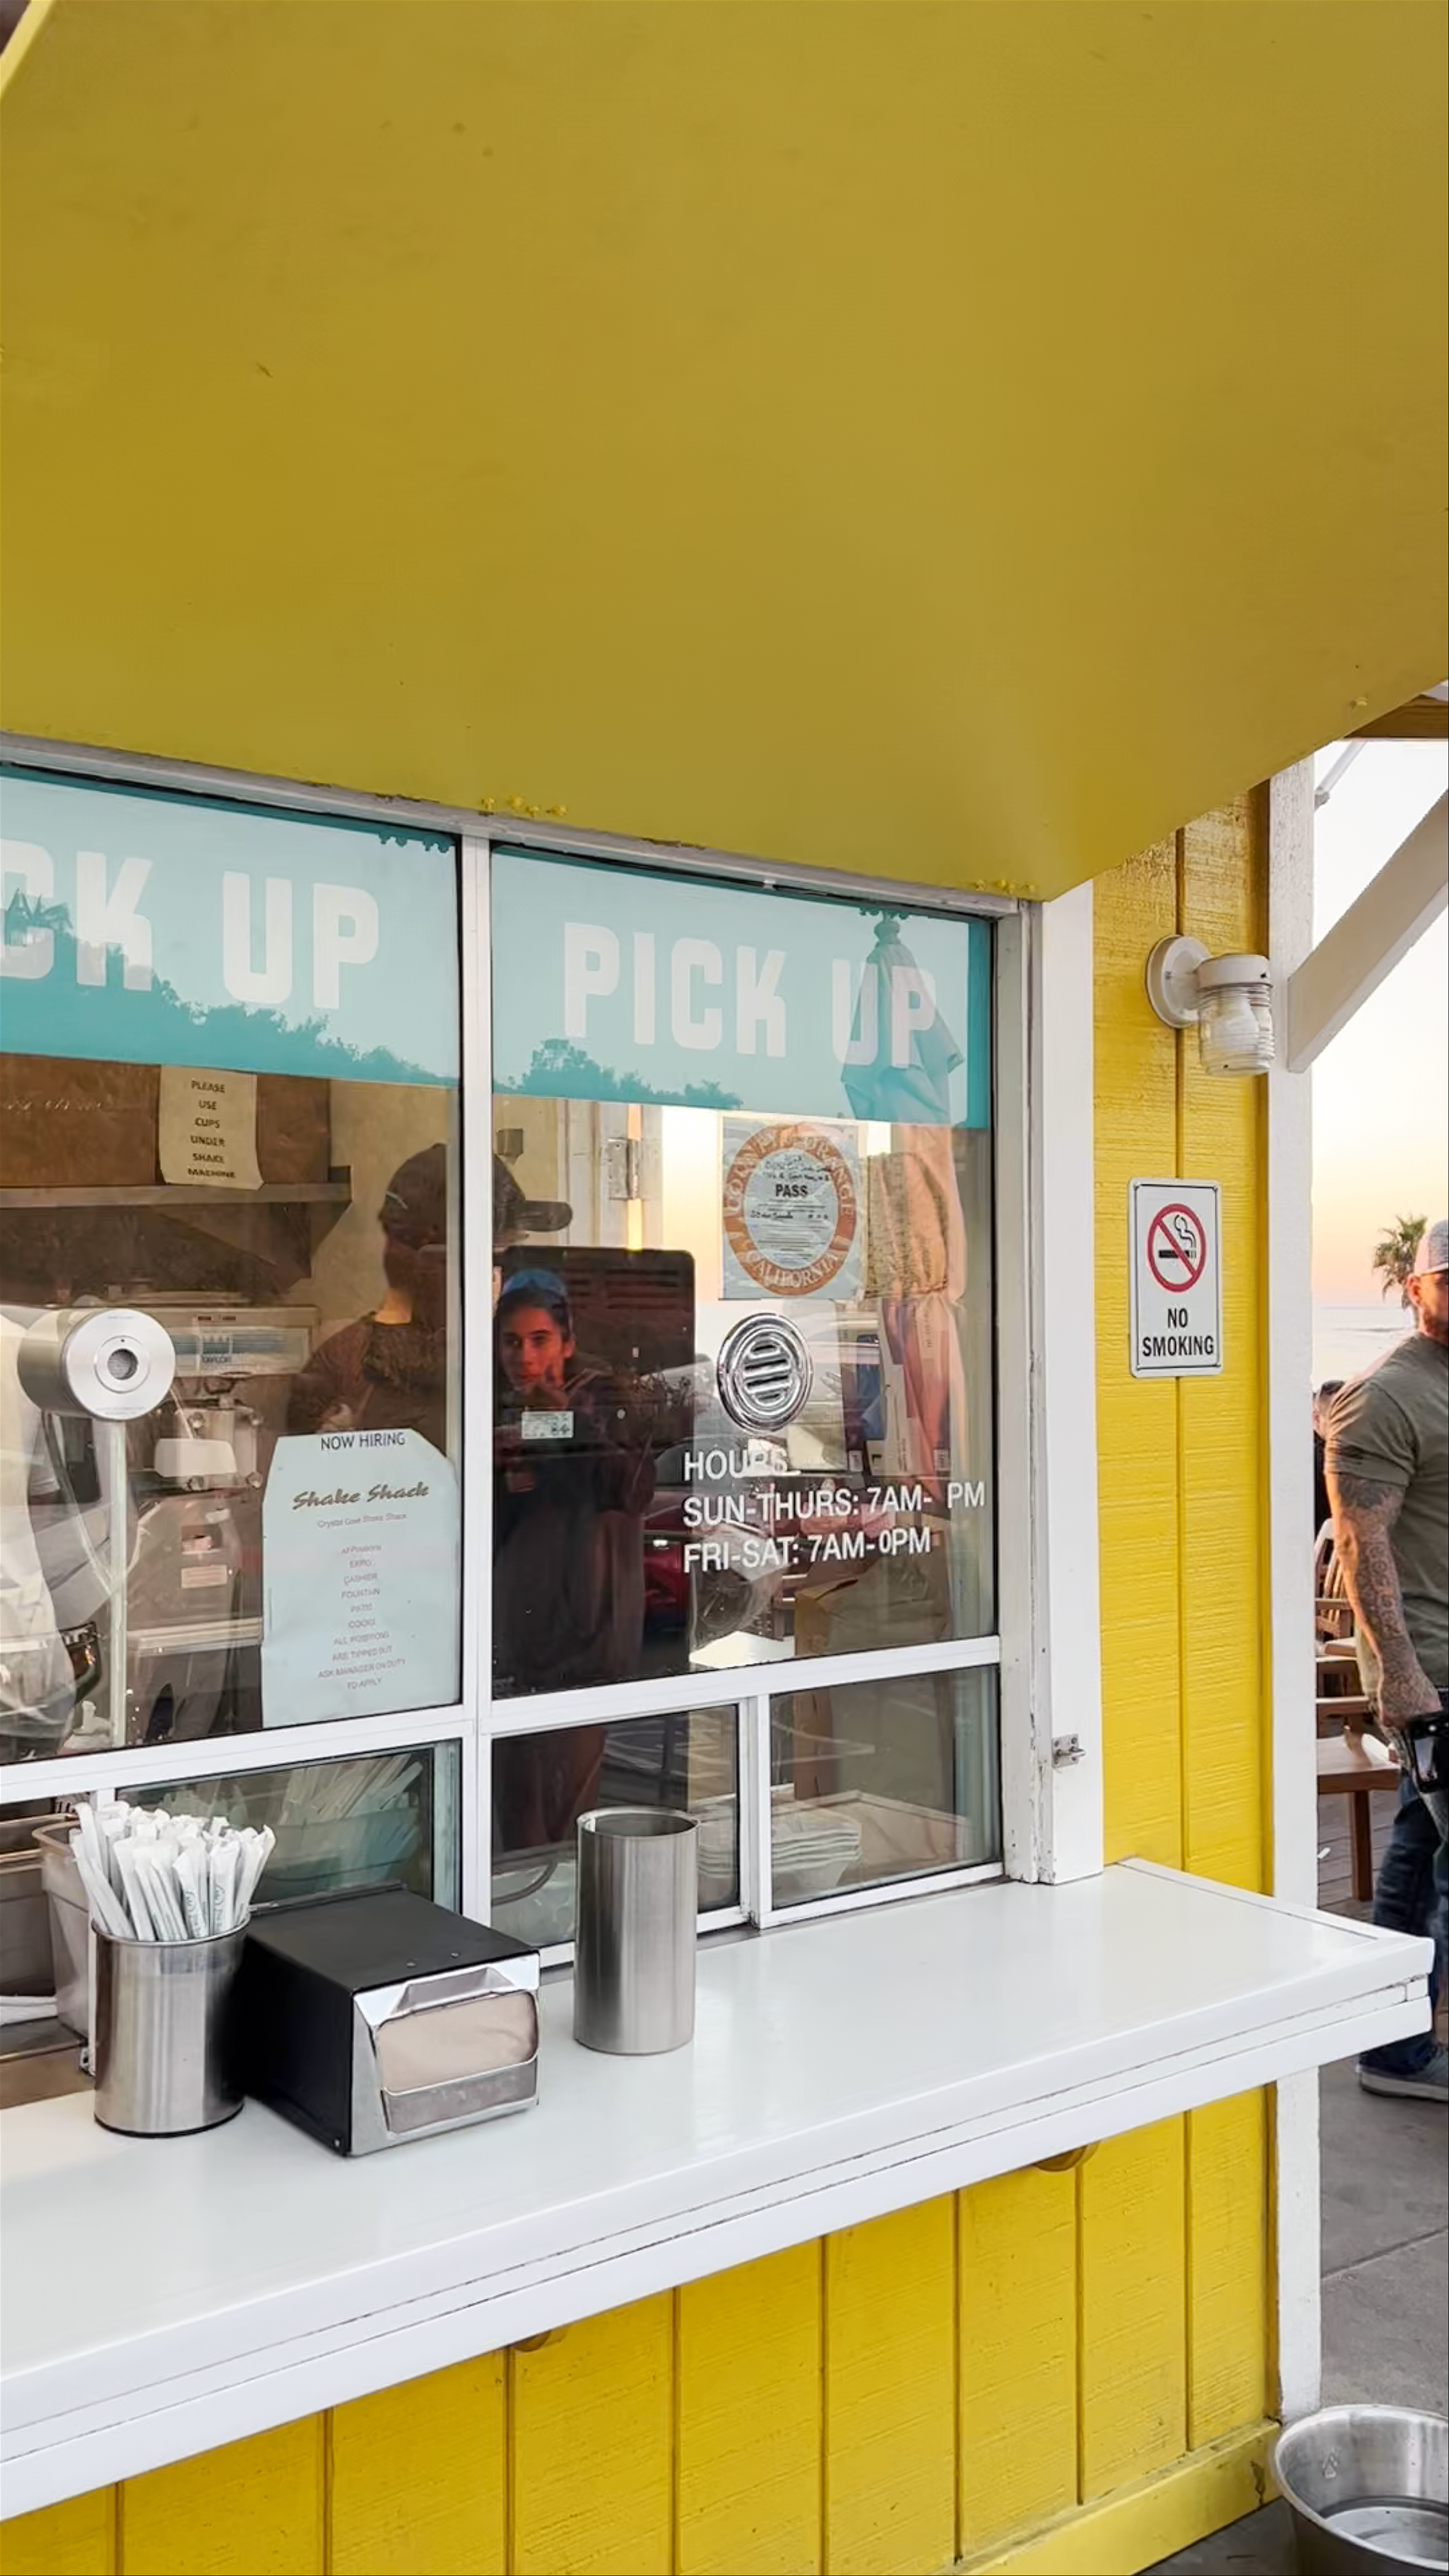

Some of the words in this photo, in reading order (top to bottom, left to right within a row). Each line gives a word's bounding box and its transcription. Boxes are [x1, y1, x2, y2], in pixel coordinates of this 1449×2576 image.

[223, 870, 378, 1010] UP
[564, 922, 787, 1058] PICK
[832, 958, 936, 1069] UP
[191, 1080, 225, 1093] PLEASE
[198, 1100, 217, 1110] USE
[195, 1117, 220, 1129] CUPS
[190, 1135, 225, 1147] UNDER
[192, 1153, 225, 1163] SHAKE
[187, 1168, 236, 1178] MACHINE
[775, 1184, 808, 1198] PASS
[1168, 1307, 1188, 1329] NO
[1142, 1335, 1214, 1357] SMOKING
[321, 1435, 354, 1450] NOW
[359, 1432, 405, 1448] HIRING
[292, 1489, 361, 1510] Shake
[367, 1481, 429, 1503] Shack
[683, 1487, 859, 1528] SUN-THURS:
[683, 1535, 800, 1573] FRI-SAT:
